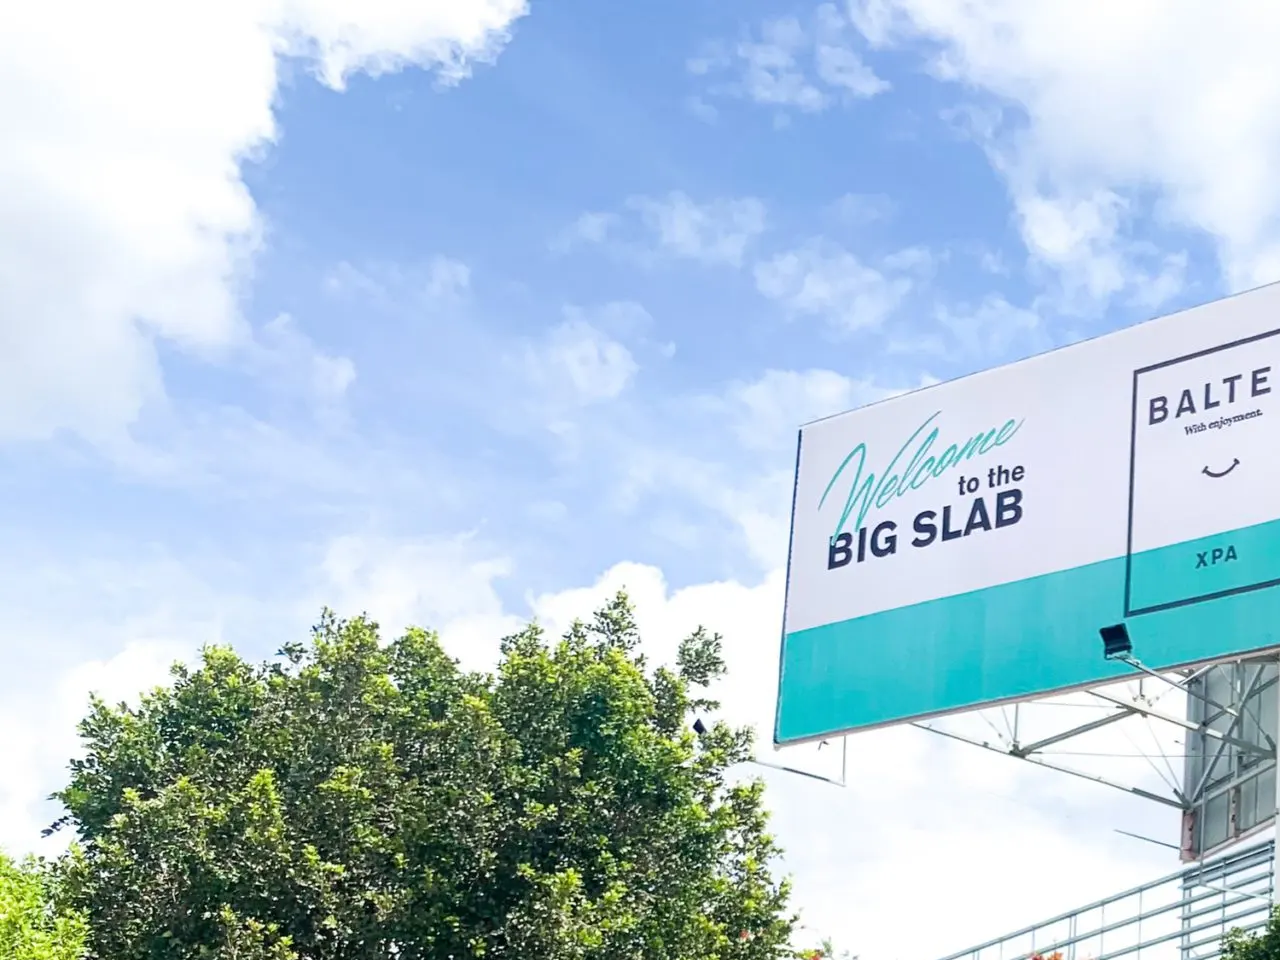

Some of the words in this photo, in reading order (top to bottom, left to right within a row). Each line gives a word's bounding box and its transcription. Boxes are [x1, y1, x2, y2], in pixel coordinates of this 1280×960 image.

[1184, 422, 1207, 436] With
[818, 410, 1026, 546] Welcome
[958, 476, 980, 496] to
[988, 465, 1025, 489] the
[828, 520, 898, 570] BIG
[911, 488, 1024, 548] SLAB
[1195, 545, 1238, 569] XPA
